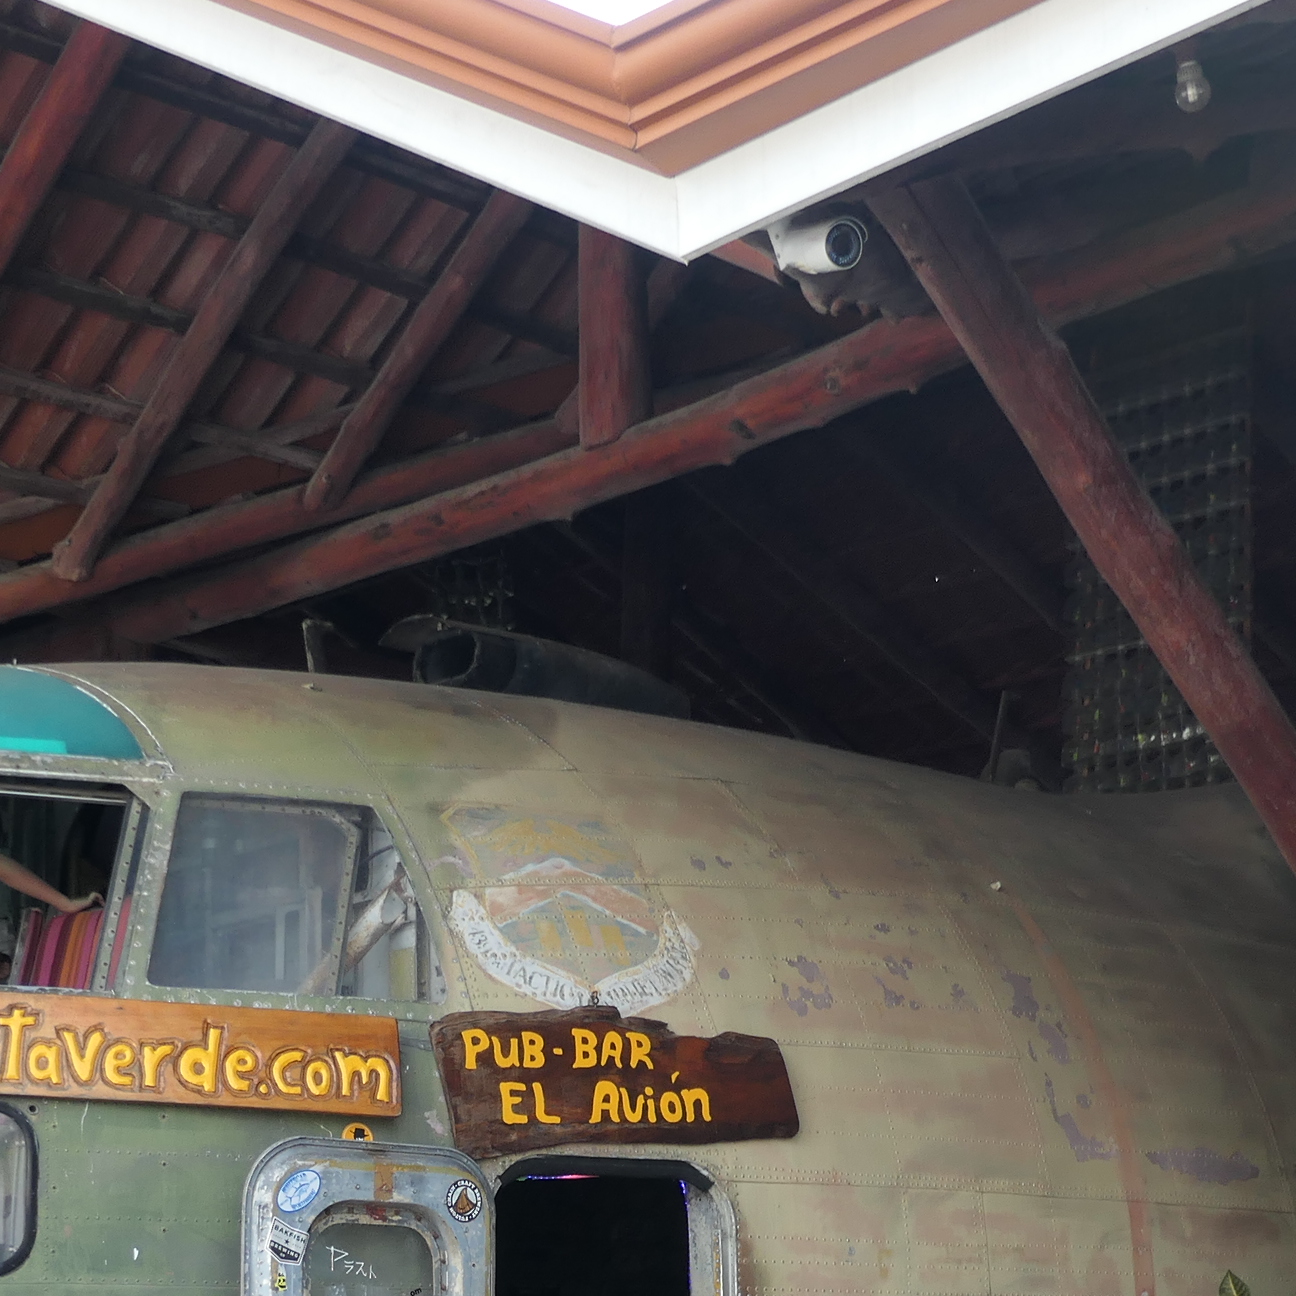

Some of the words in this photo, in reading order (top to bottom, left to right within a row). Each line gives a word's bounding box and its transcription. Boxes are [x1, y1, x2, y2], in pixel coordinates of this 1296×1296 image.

[499, 1081, 561, 1124] EL
[589, 1071, 711, 1123] Avión
[274, 1224, 306, 1243] BAKFISH
[270, 1241, 299, 1258] BREWING
